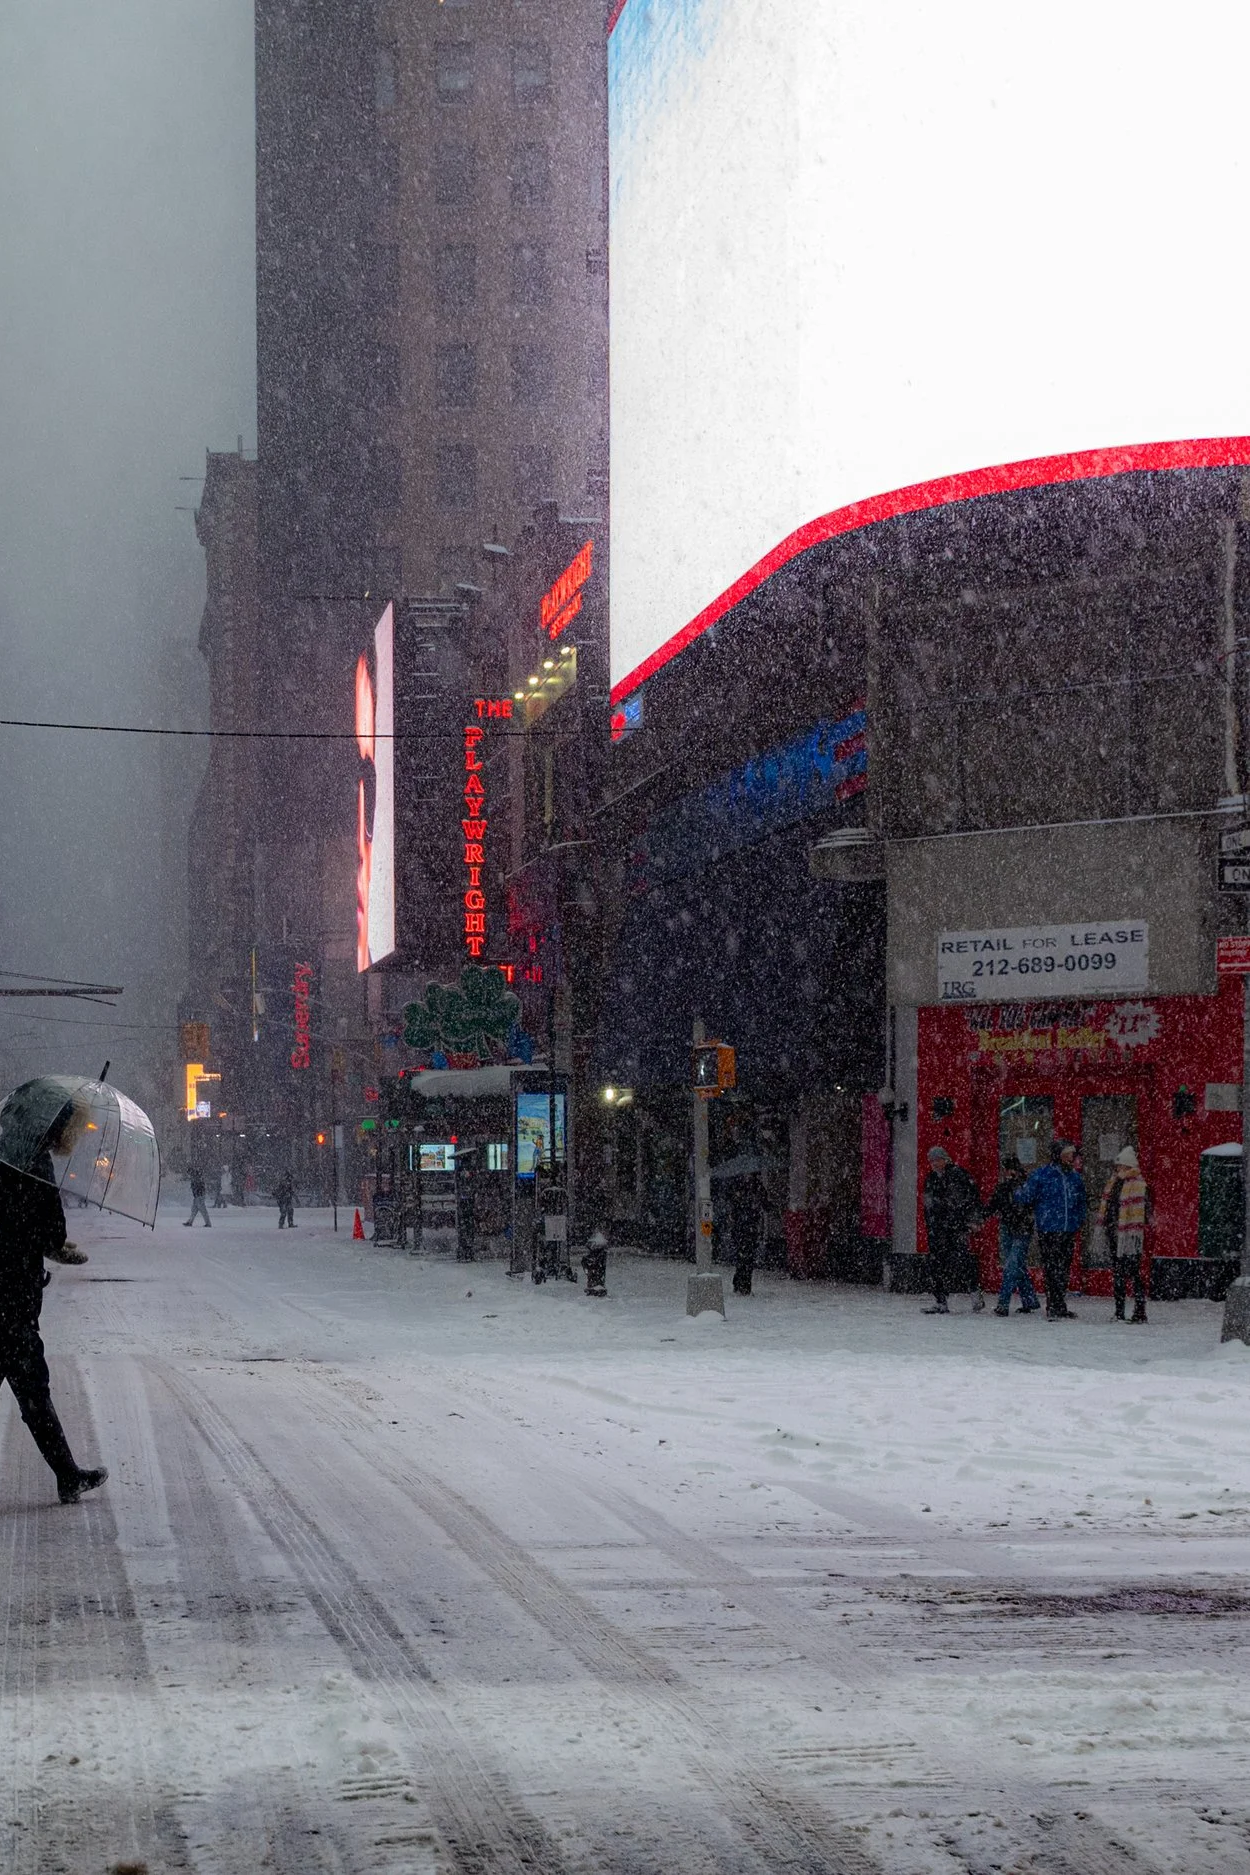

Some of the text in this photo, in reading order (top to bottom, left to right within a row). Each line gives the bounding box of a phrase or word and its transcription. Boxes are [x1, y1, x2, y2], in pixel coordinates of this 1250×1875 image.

[475, 700, 513, 719] THE
[461, 727, 487, 957] PLAYWRIGHT
[941, 930, 1144, 954] RETAIL FOR LEASE
[972, 953, 1117, 977] 212-689-0099
